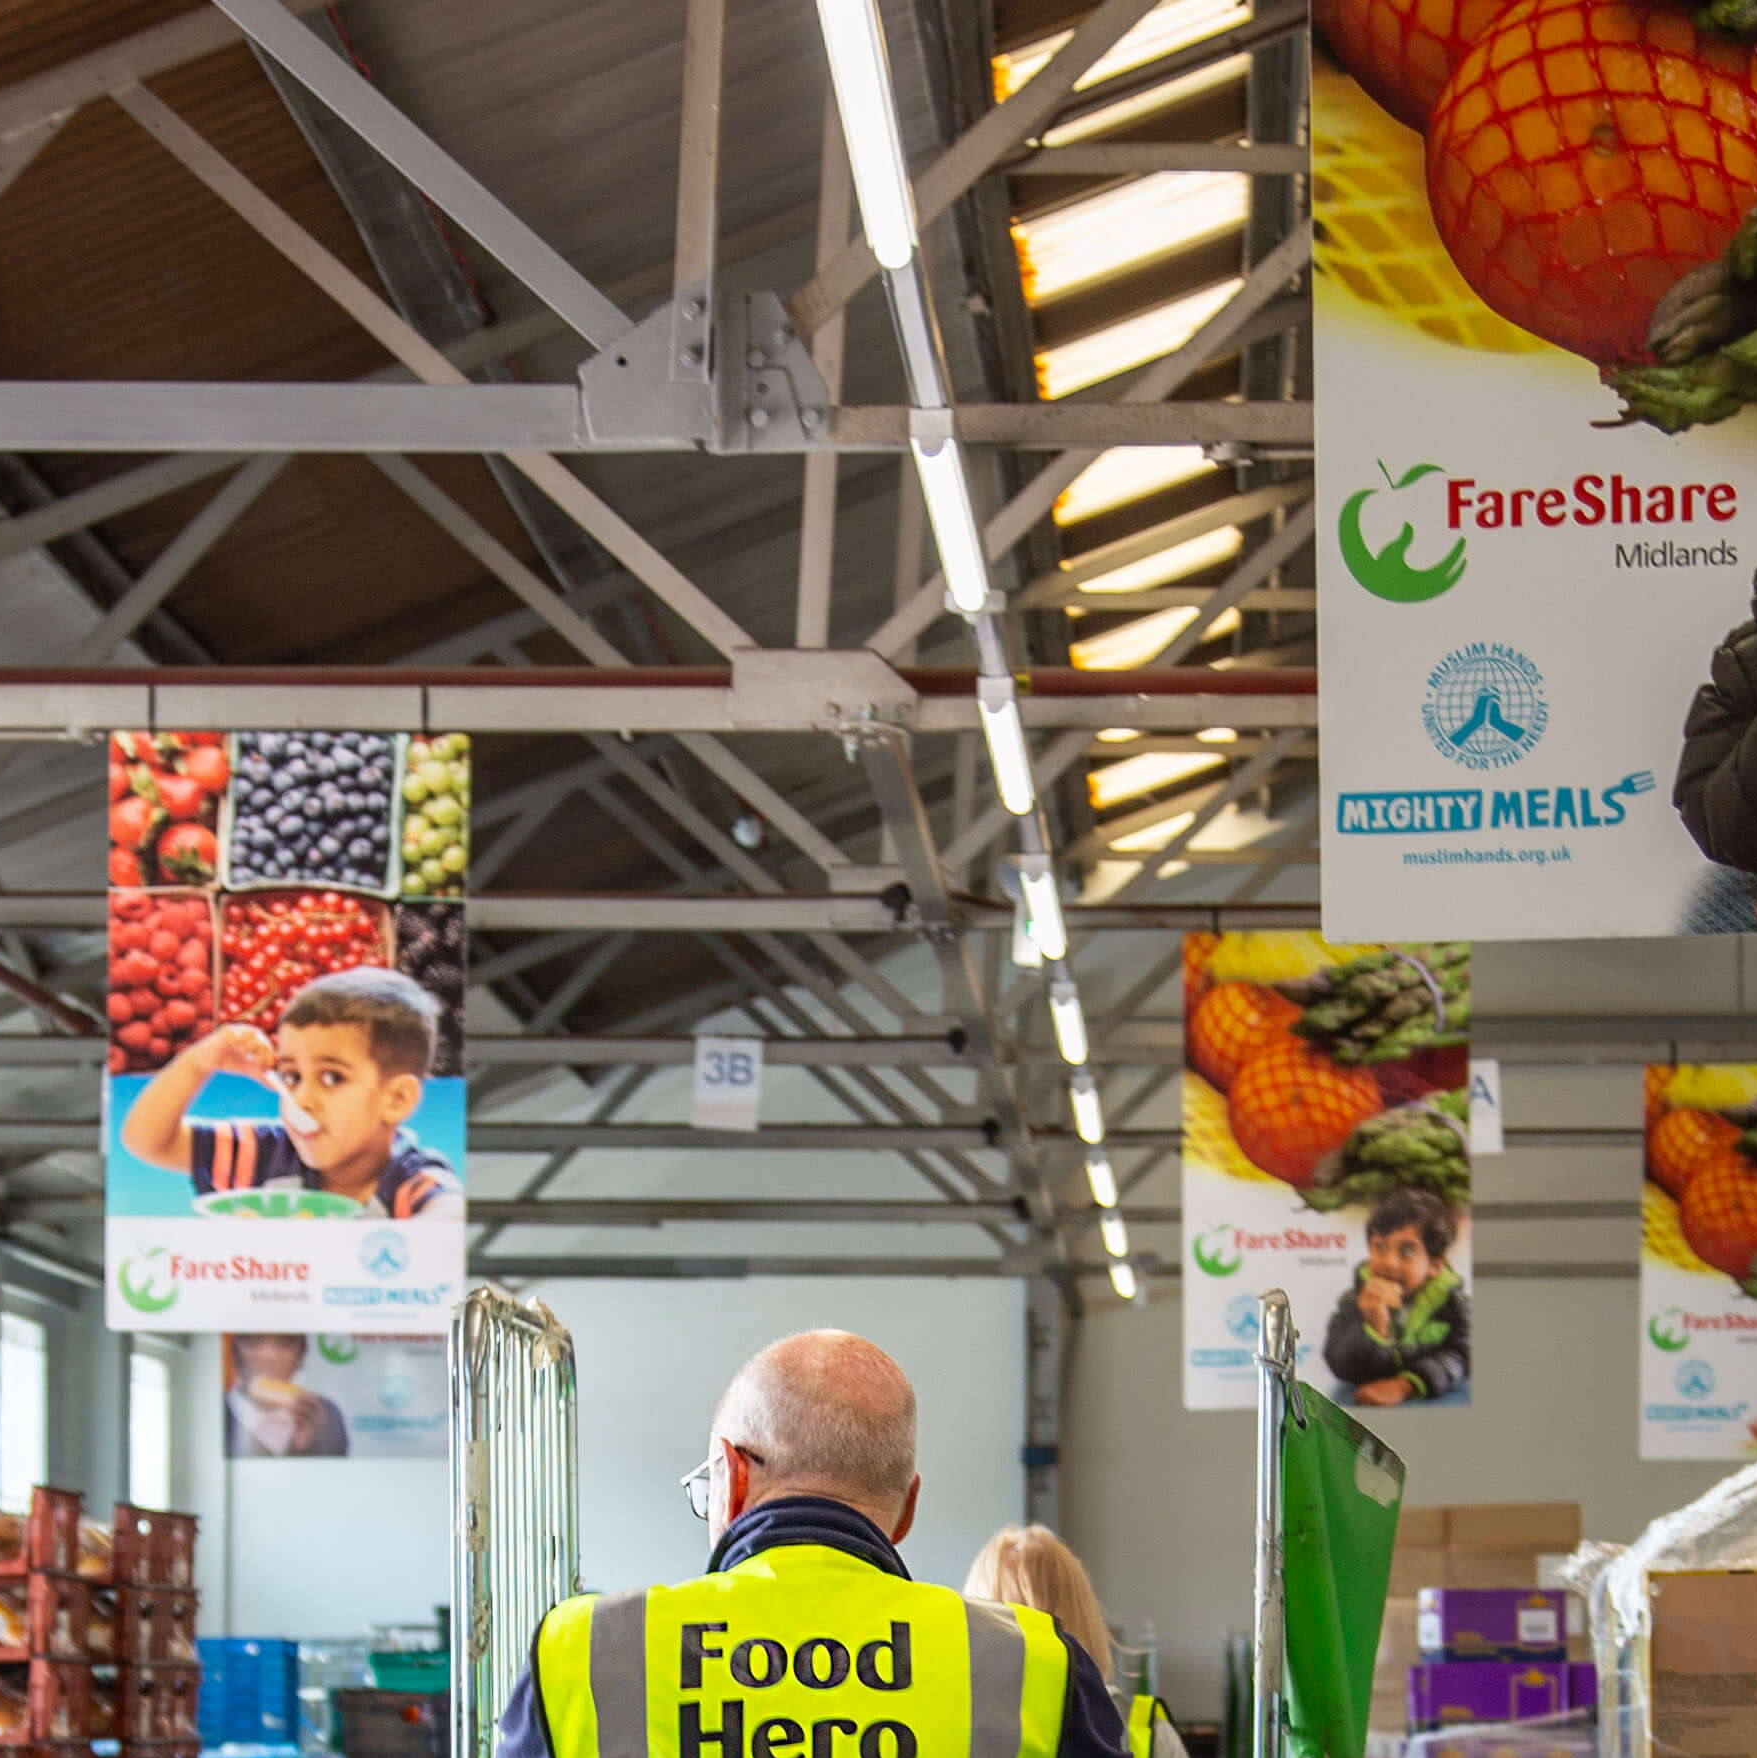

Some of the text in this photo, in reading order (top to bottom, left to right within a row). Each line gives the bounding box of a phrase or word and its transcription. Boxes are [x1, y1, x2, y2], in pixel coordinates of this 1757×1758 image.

[1447, 474, 1737, 529] FareShare
[1615, 540, 1738, 568] Midlands
[1426, 641, 1544, 689] MUSLIM HANDS
[1342, 785, 1627, 831] MIGHTY MEALS
[1402, 844, 1572, 866] muslimhands.org.uk
[703, 1050, 754, 1087] 3B
[1471, 1075, 1495, 1107] A
[1233, 1228, 1347, 1250] FareShare
[170, 1254, 310, 1281] FareShare
[679, 1621, 913, 1692] Food
